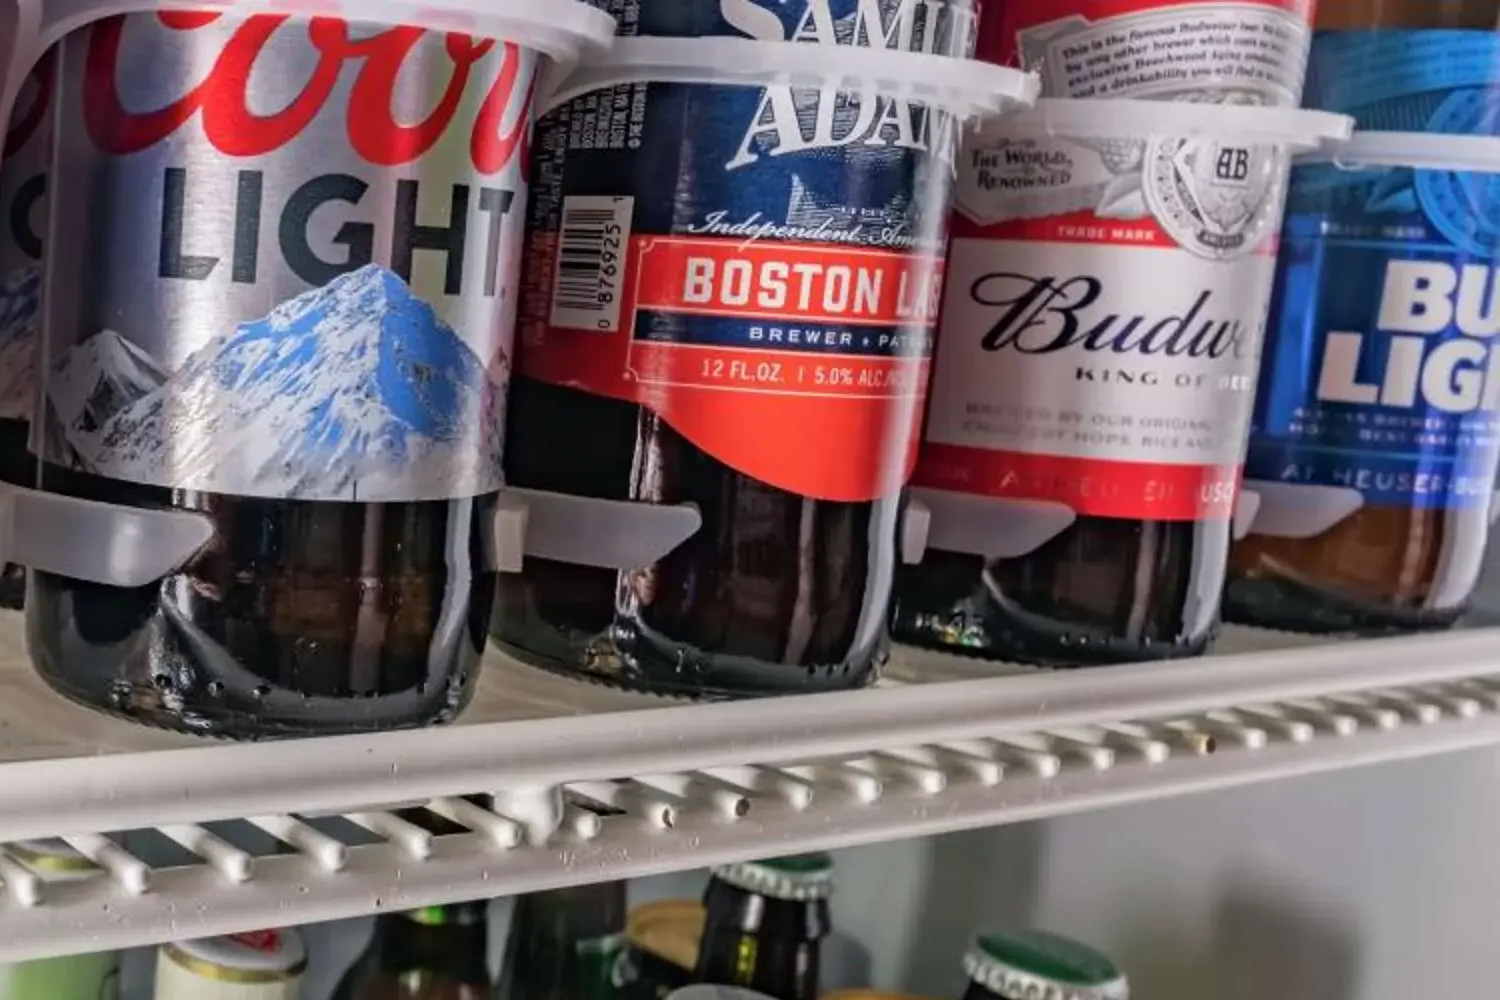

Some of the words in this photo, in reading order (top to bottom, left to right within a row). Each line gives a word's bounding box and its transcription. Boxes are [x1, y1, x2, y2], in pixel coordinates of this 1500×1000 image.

[1105, 34, 1127, 47] the
[971, 150, 1002, 169] THE
[976, 170, 1073, 191] RENOWNED
[157, 166, 515, 299] LIGHT
[687, 209, 862, 252] Independent
[1056, 225, 1105, 241] TRADE
[1110, 226, 1156, 242] MARK
[597, 223, 622, 304] 876925
[683, 256, 885, 316] BOSTON
[749, 326, 853, 346] BREWER
[701, 358, 723, 377] 12
[814, 366, 854, 385] 5.0%
[1075, 366, 1158, 387] KING
[1174, 369, 1207, 388] OF
